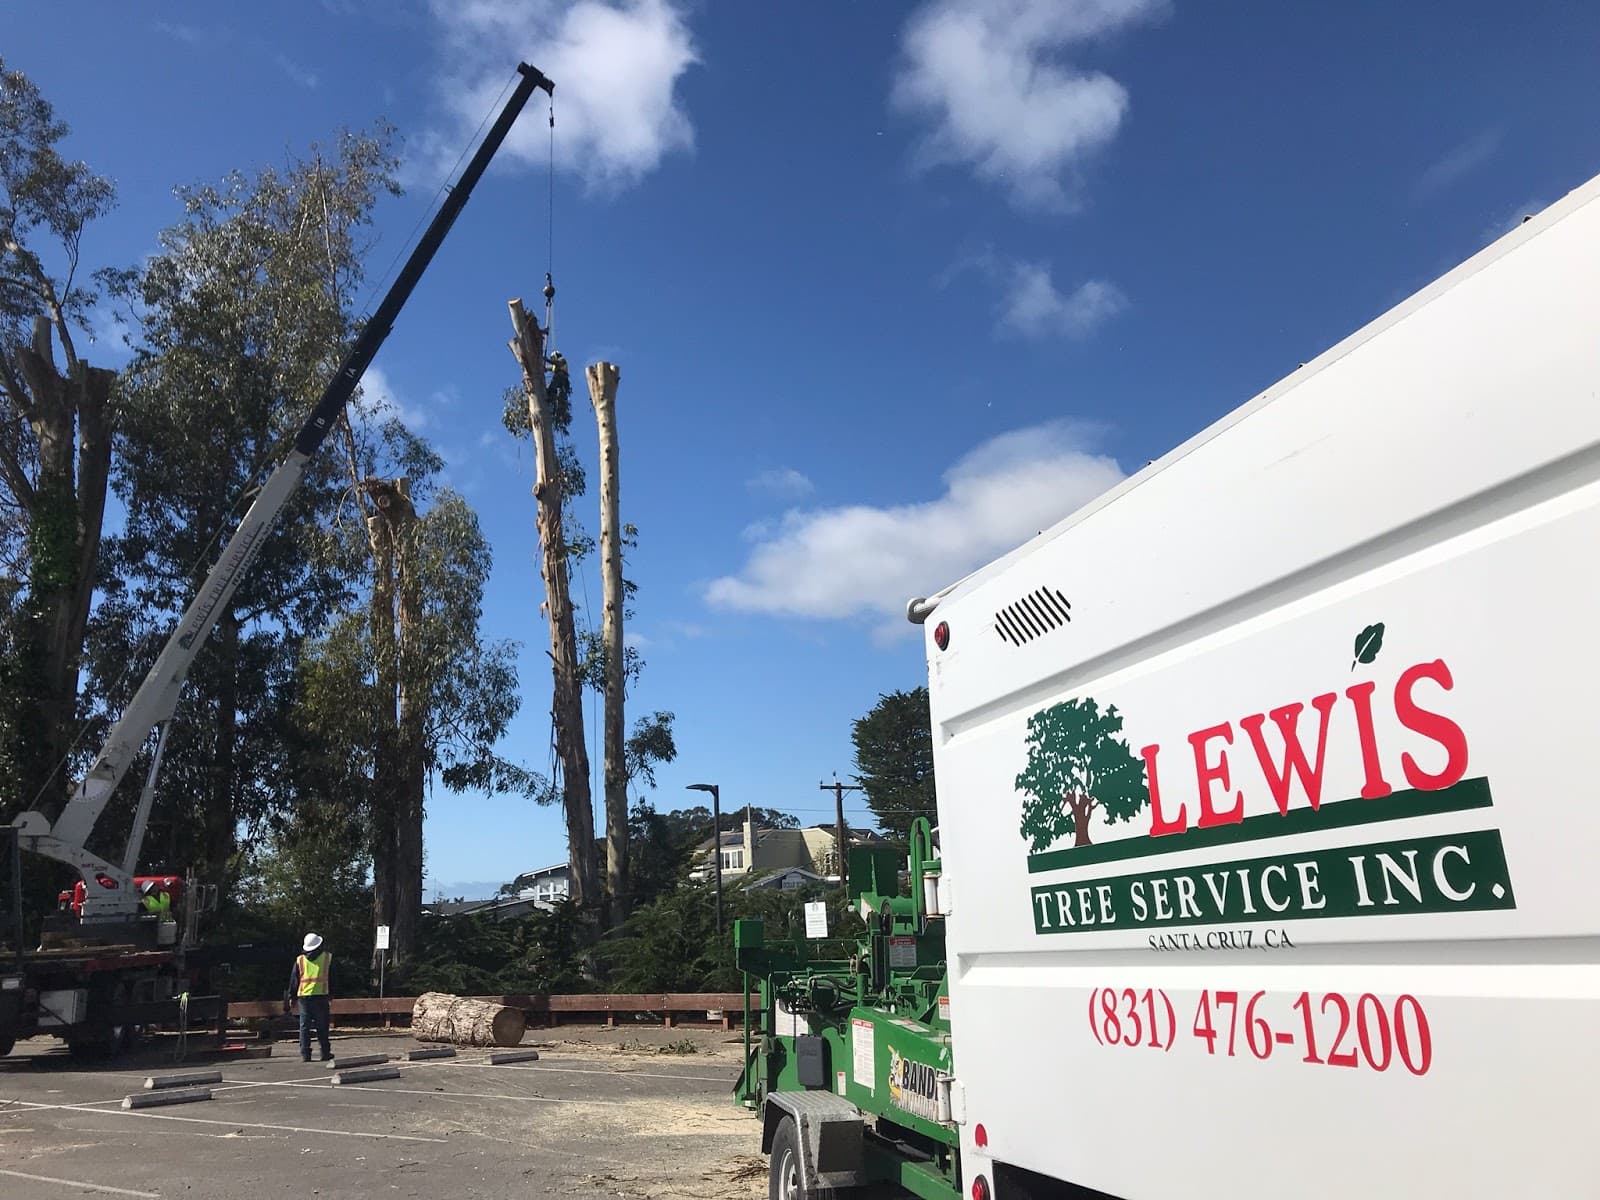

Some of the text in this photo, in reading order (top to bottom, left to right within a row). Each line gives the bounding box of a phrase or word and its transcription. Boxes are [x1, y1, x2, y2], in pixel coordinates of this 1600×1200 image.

[1140, 658, 1469, 836] LEWIS
[1035, 844, 1506, 928] TREE SERVICE INC.
[1149, 933, 1206, 951] SANTA
[1265, 929, 1296, 949] CA
[1088, 987, 1432, 1076] (831) 476-1200
